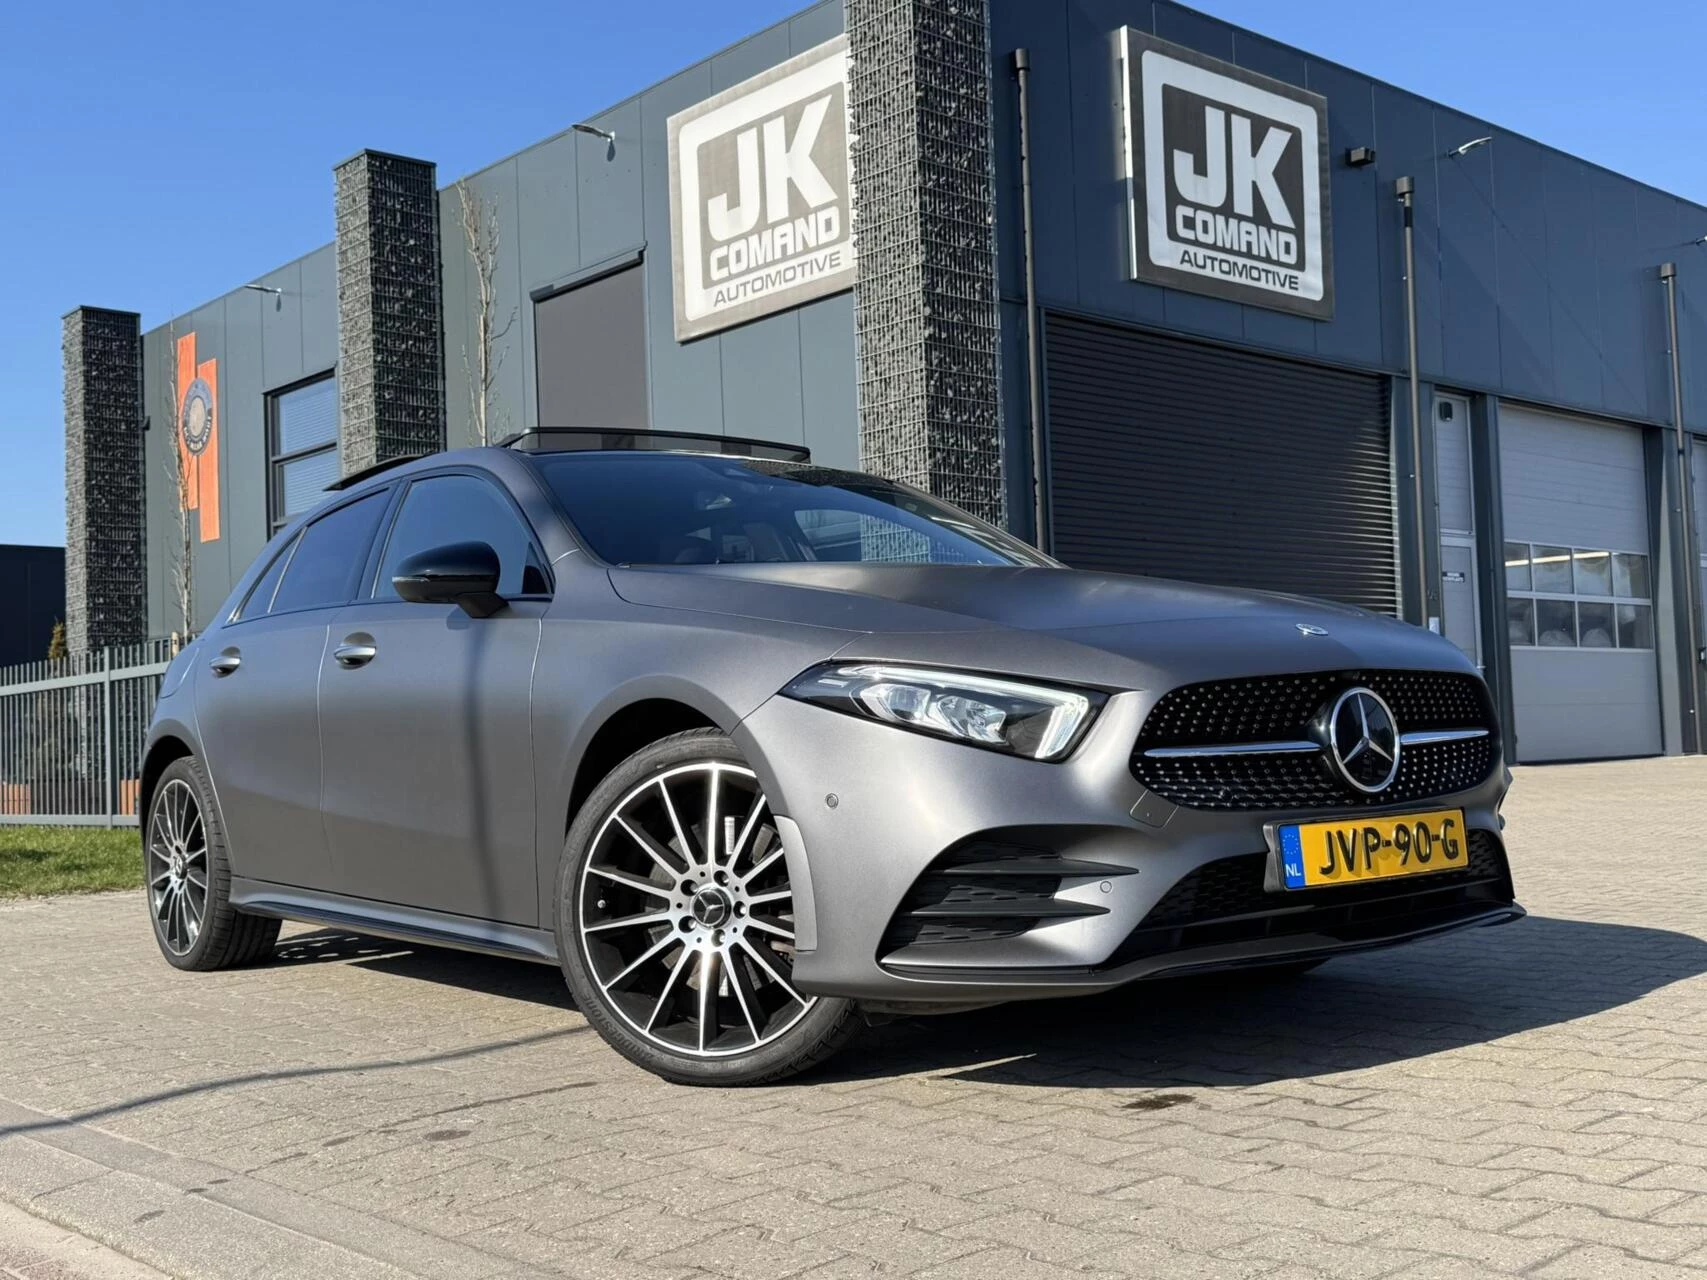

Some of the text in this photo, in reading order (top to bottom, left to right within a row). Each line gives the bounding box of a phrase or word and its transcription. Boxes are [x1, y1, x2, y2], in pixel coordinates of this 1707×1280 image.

[708, 95, 838, 242] JK
[1173, 105, 1296, 229] JK
[709, 205, 841, 282] COMAND
[1175, 204, 1298, 266] COMAND
[713, 250, 841, 307] AUTOMOTIVE
[1179, 249, 1300, 291] AUTOMOTIVE
[1285, 863, 1302, 878] NL
[1319, 818, 1460, 877] JVP-90-G
